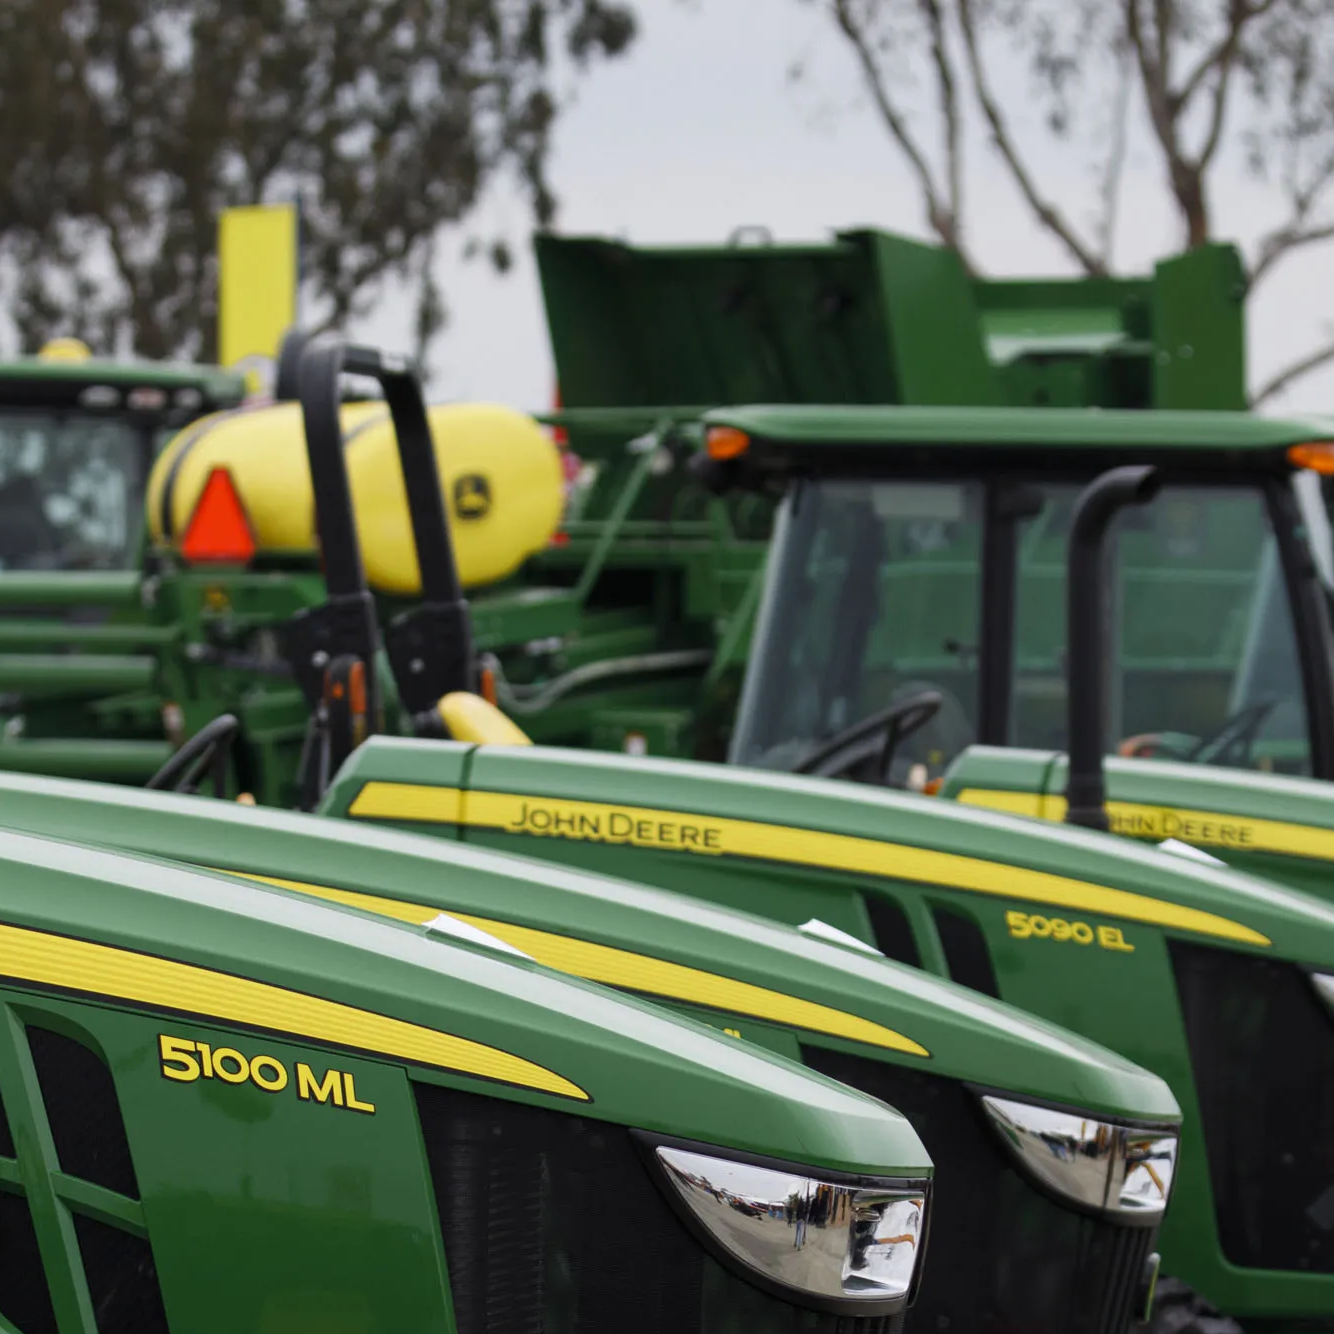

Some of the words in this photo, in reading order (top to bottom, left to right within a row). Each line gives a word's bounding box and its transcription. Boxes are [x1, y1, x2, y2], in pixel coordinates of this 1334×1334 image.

[510, 801, 600, 834] JOHN
[609, 812, 723, 848] DEERE
[1162, 810, 1254, 843] DEERE
[1004, 910, 1094, 945] 5090
[1096, 924, 1136, 953] EL
[158, 1033, 289, 1093] 5100
[294, 1061, 376, 1116] ML
